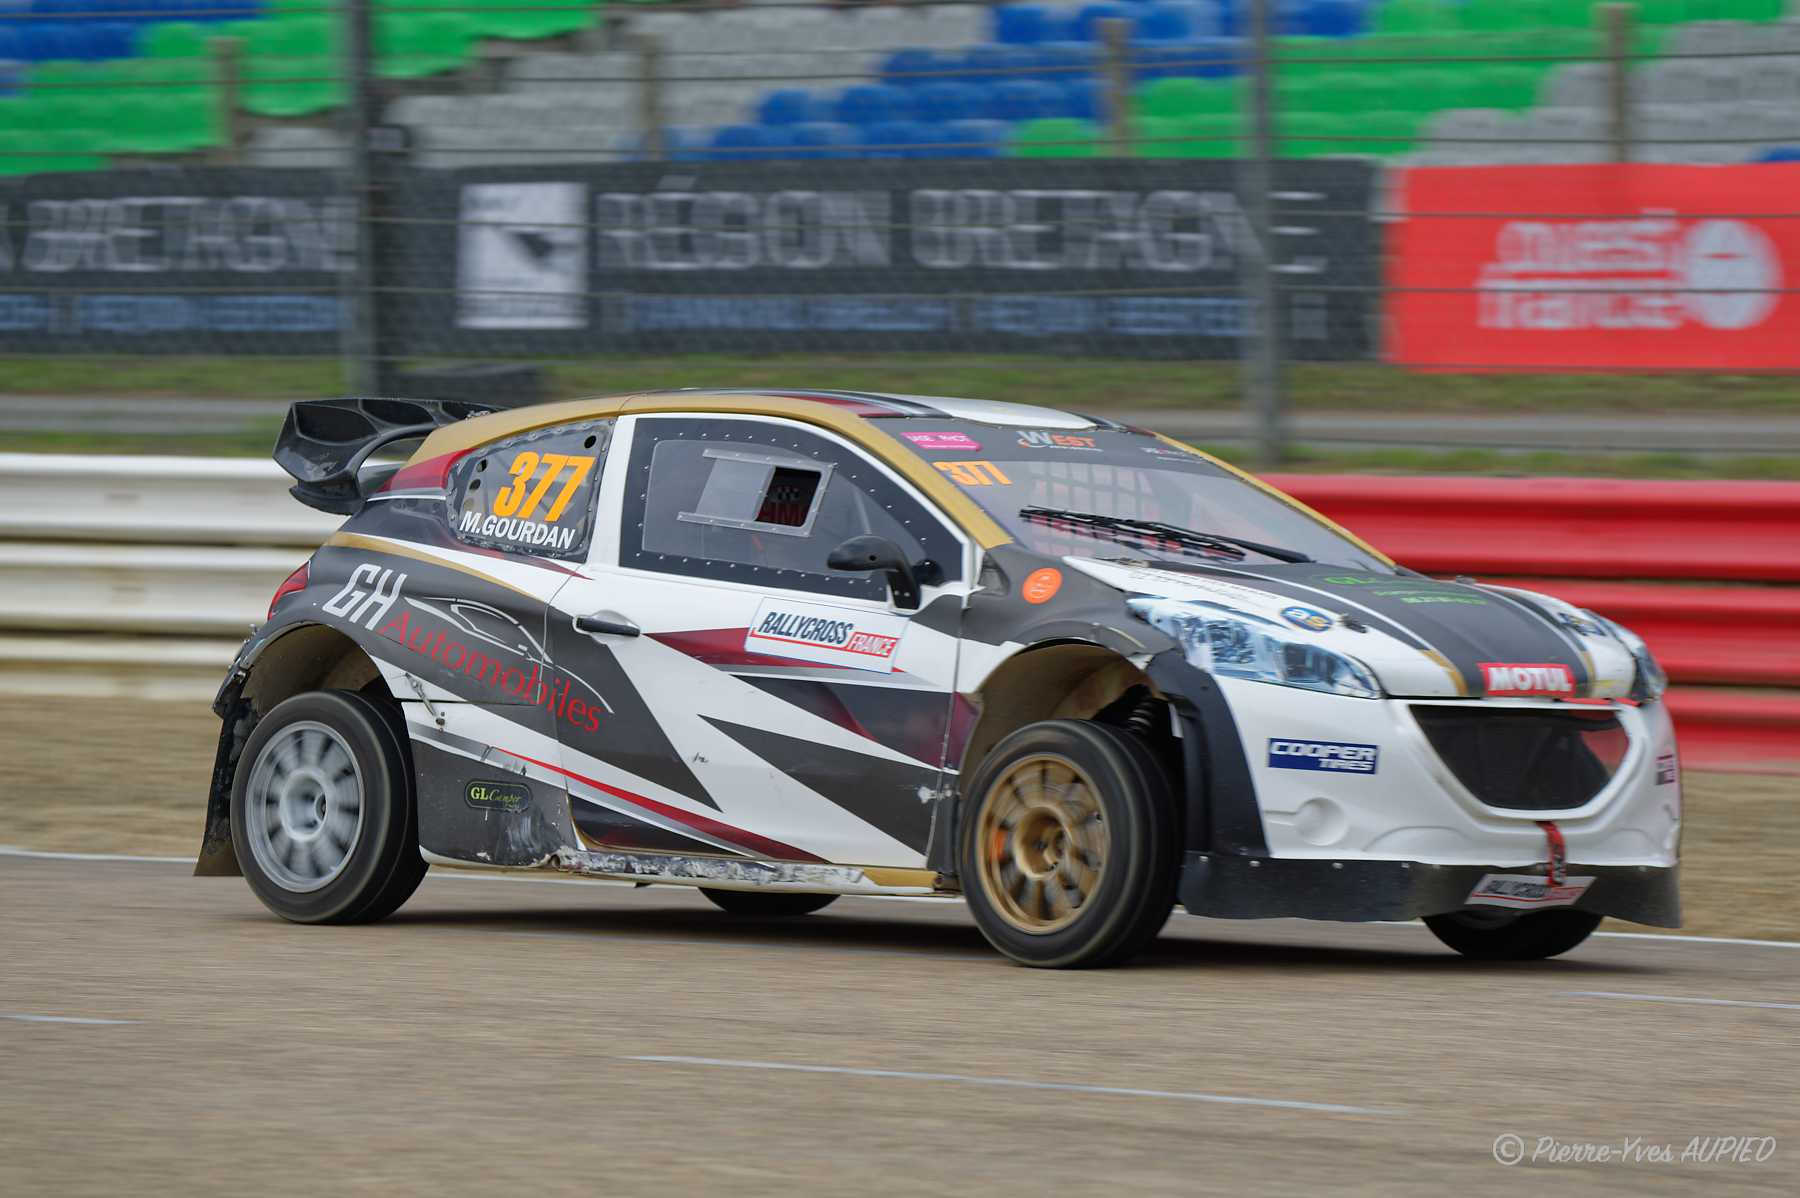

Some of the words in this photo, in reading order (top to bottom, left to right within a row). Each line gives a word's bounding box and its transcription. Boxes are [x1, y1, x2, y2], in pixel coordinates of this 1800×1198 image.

[492, 451, 596, 522] 377
[931, 460, 1013, 486] 377
[459, 510, 576, 549] M.GOURDAN
[322, 563, 408, 632] GH
[374, 611, 608, 734] Automobiles
[758, 611, 854, 645] RALLYCROSS
[849, 634, 897, 656] FRANCE
[1487, 667, 1571, 692] MOTUL
[1271, 741, 1377, 761] COOPER
[1317, 758, 1375, 771] TIRES
